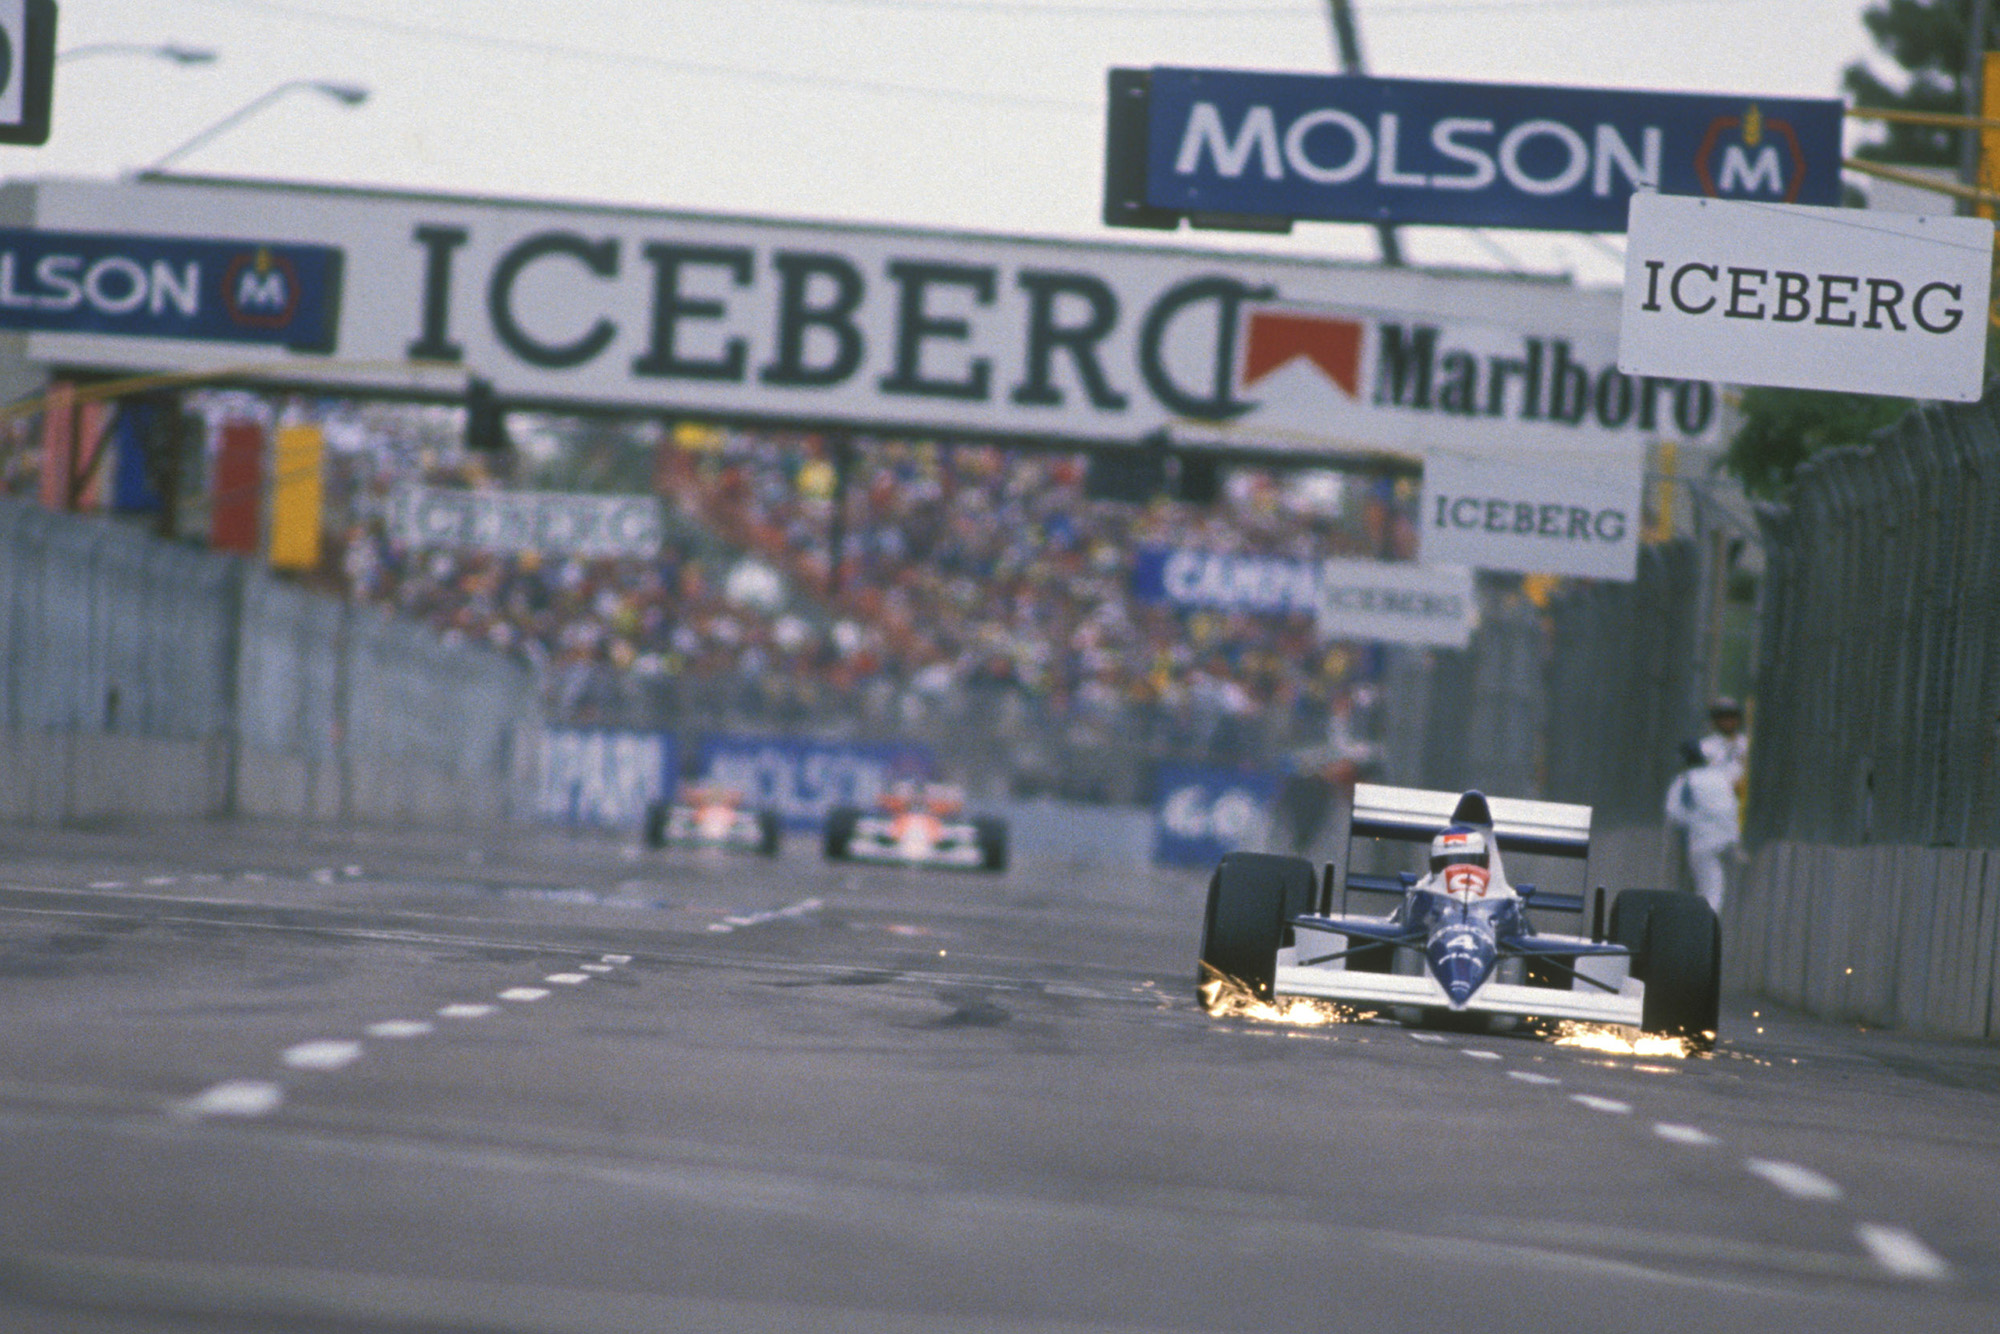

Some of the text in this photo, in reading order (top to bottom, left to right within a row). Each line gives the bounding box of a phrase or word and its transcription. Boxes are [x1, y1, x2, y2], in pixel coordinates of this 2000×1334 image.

[1175, 102, 1662, 196] MOLSON
[1641, 259, 1964, 335] ICEBERG
[1374, 321, 1713, 436] Marlboro
[1434, 494, 1627, 542] ICEBERG
